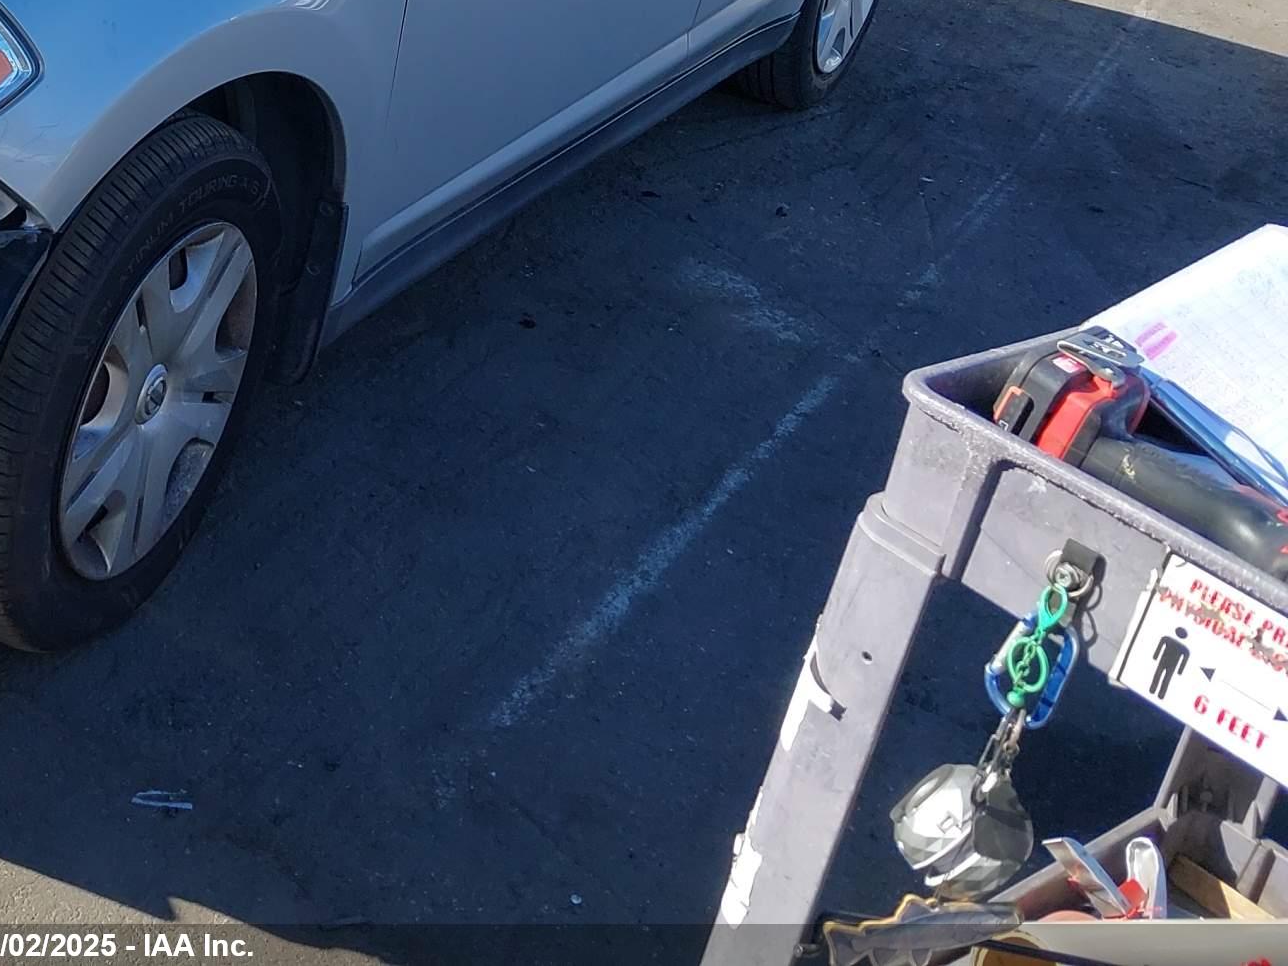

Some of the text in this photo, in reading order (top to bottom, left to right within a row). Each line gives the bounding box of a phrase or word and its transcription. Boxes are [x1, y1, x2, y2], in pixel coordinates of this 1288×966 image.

[1190, 579, 1256, 626] PLEASE
[1193, 694, 1270, 750] 6 FEET
